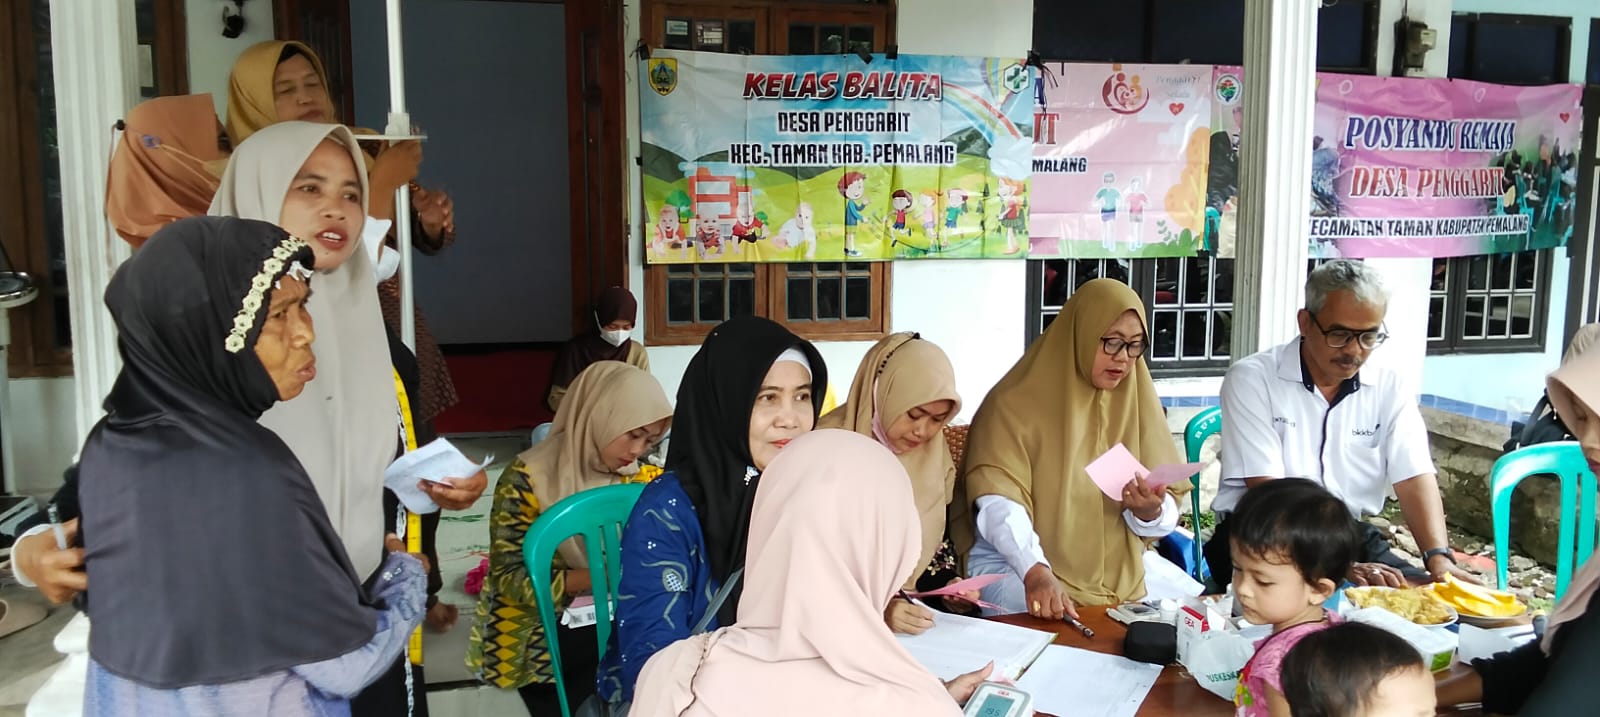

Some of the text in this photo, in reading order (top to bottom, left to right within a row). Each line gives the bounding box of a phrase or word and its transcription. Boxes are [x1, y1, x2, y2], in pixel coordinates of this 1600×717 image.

[743, 72, 943, 100] KELAS BALITA
[778, 112, 911, 132] DESA PENGGARIT
[1345, 116, 1516, 153] POSYANDU REMAJA
[731, 144, 955, 164] KEC. TAMAN KAB. PEMALANG
[1350, 167, 1505, 197] DESA PENGGARIT
[1309, 216, 1529, 236] ECAMATAN TAMAN KABUPATEN PEMALANG
